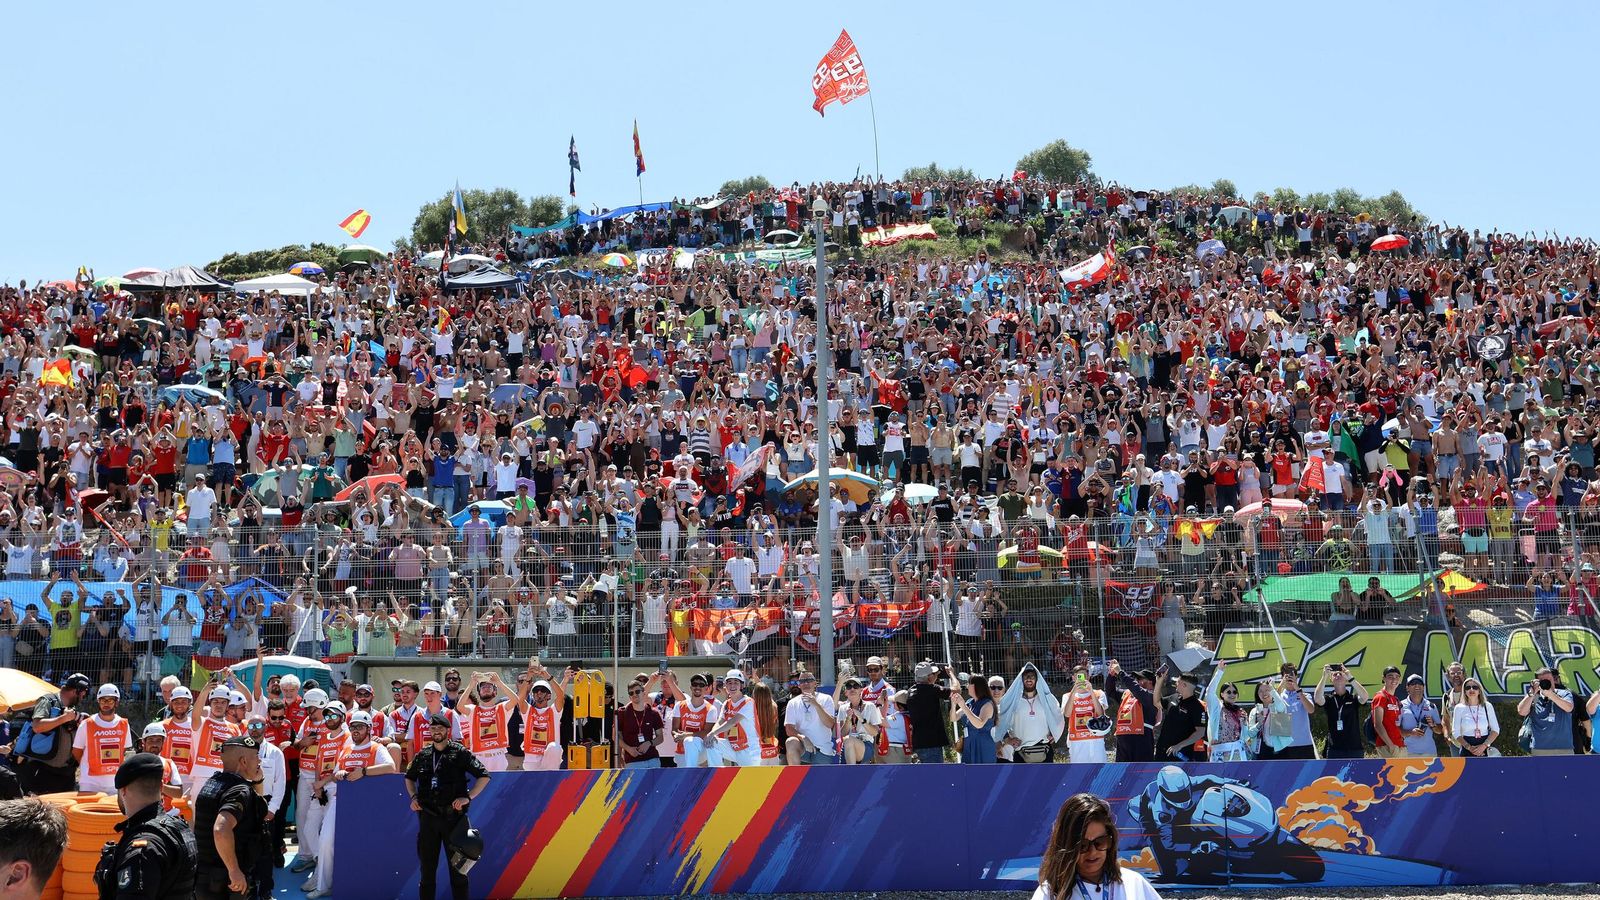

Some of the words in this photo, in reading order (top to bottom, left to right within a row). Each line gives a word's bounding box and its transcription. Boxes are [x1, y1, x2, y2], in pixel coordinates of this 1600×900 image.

[1124, 585, 1154, 600] 93
[1200, 627, 1417, 705] 24
[1423, 625, 1600, 700] MAR
